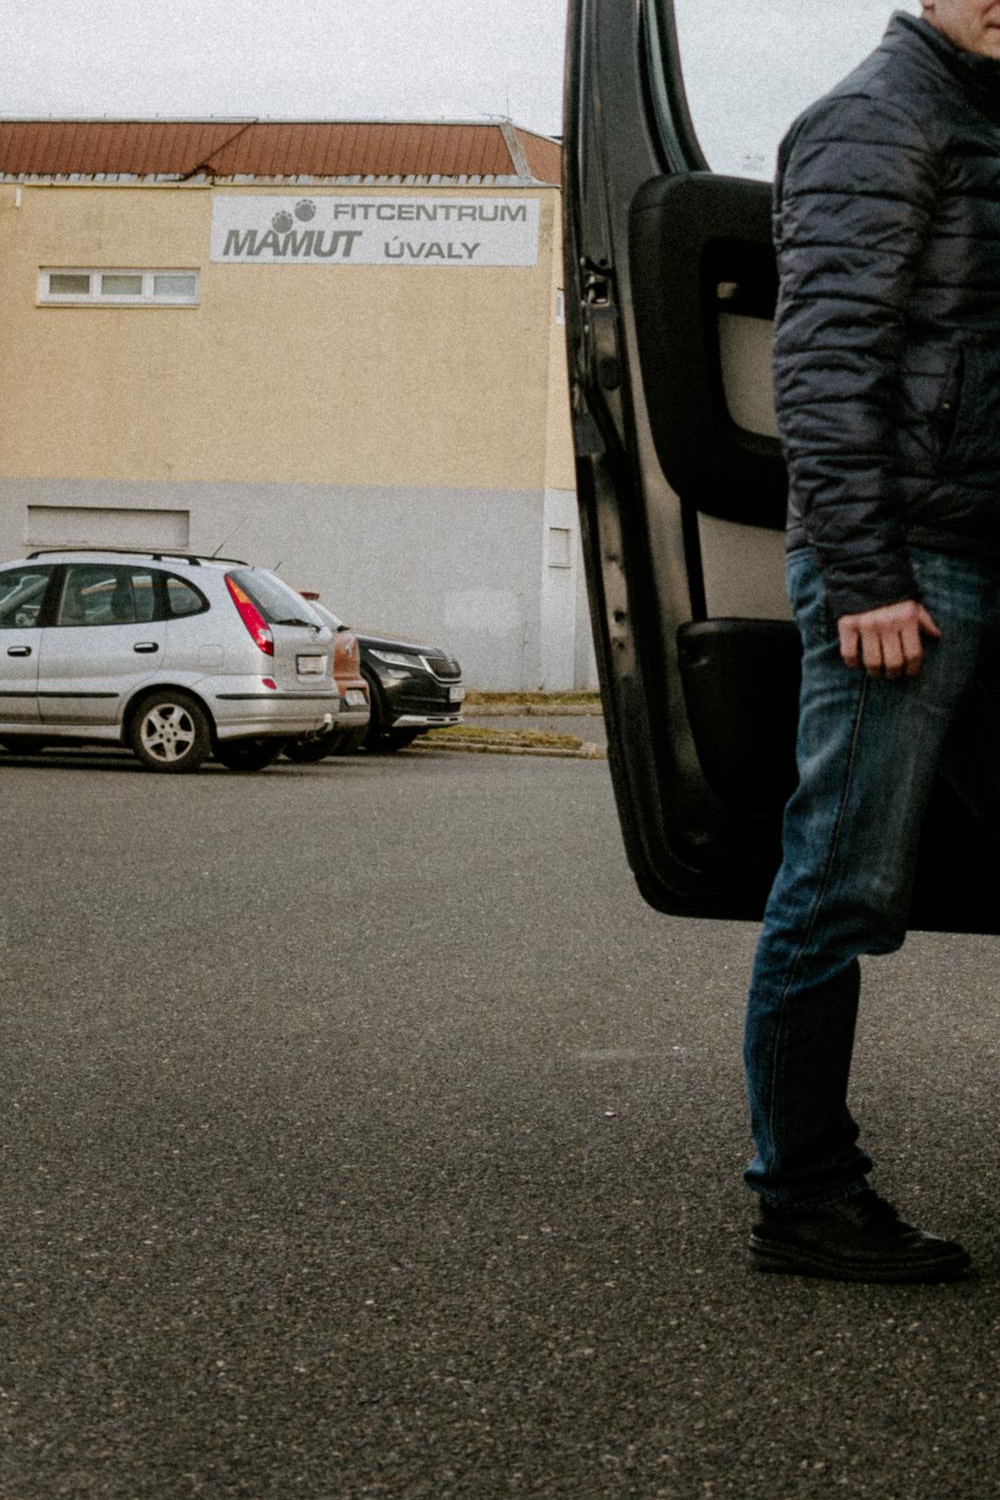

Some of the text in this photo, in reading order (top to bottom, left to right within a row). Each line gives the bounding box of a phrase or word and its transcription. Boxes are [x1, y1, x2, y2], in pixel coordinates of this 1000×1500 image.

[333, 203, 527, 222] FITCENTRUM
[222, 229, 363, 257] MAMUT
[384, 236, 481, 259] ÚVALY
